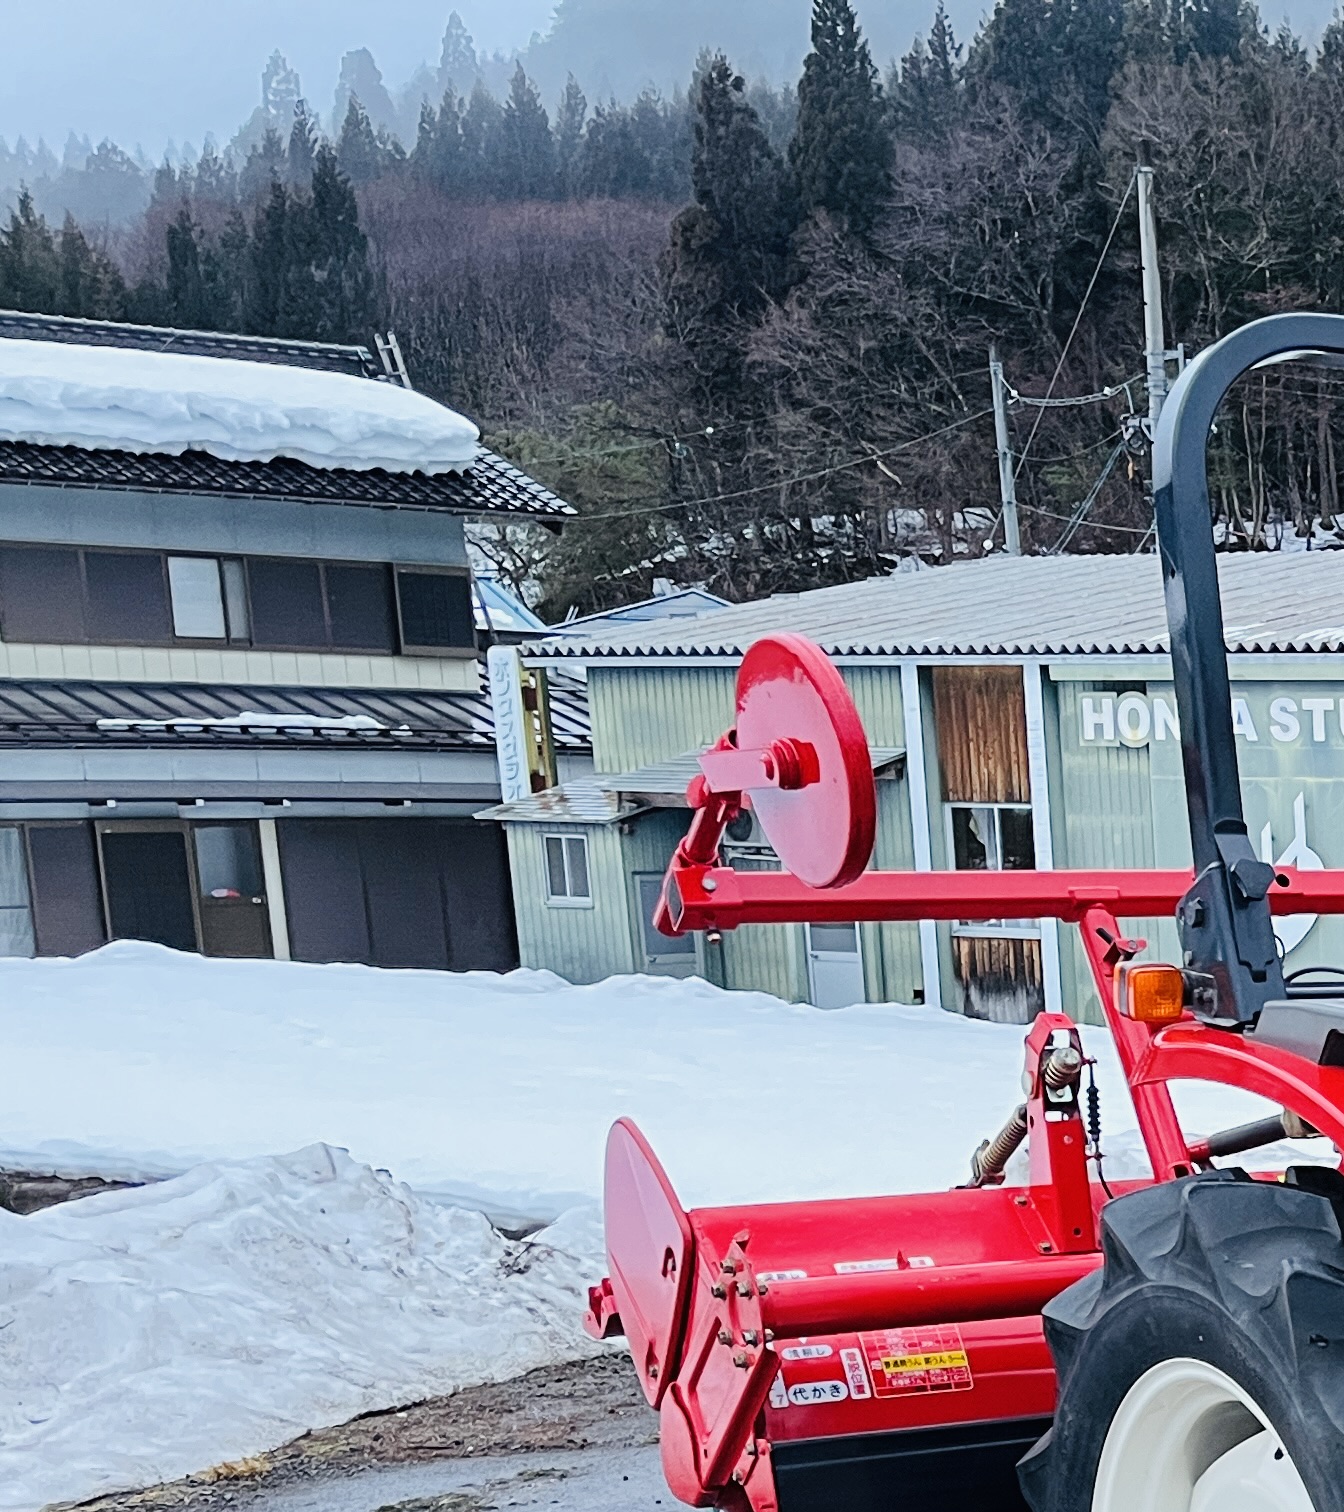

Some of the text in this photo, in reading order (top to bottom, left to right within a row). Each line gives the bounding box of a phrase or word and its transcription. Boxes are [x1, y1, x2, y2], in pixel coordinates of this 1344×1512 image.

[1082, 697, 1259, 742] HONA
[792, 1384, 841, 1402] 代かき
